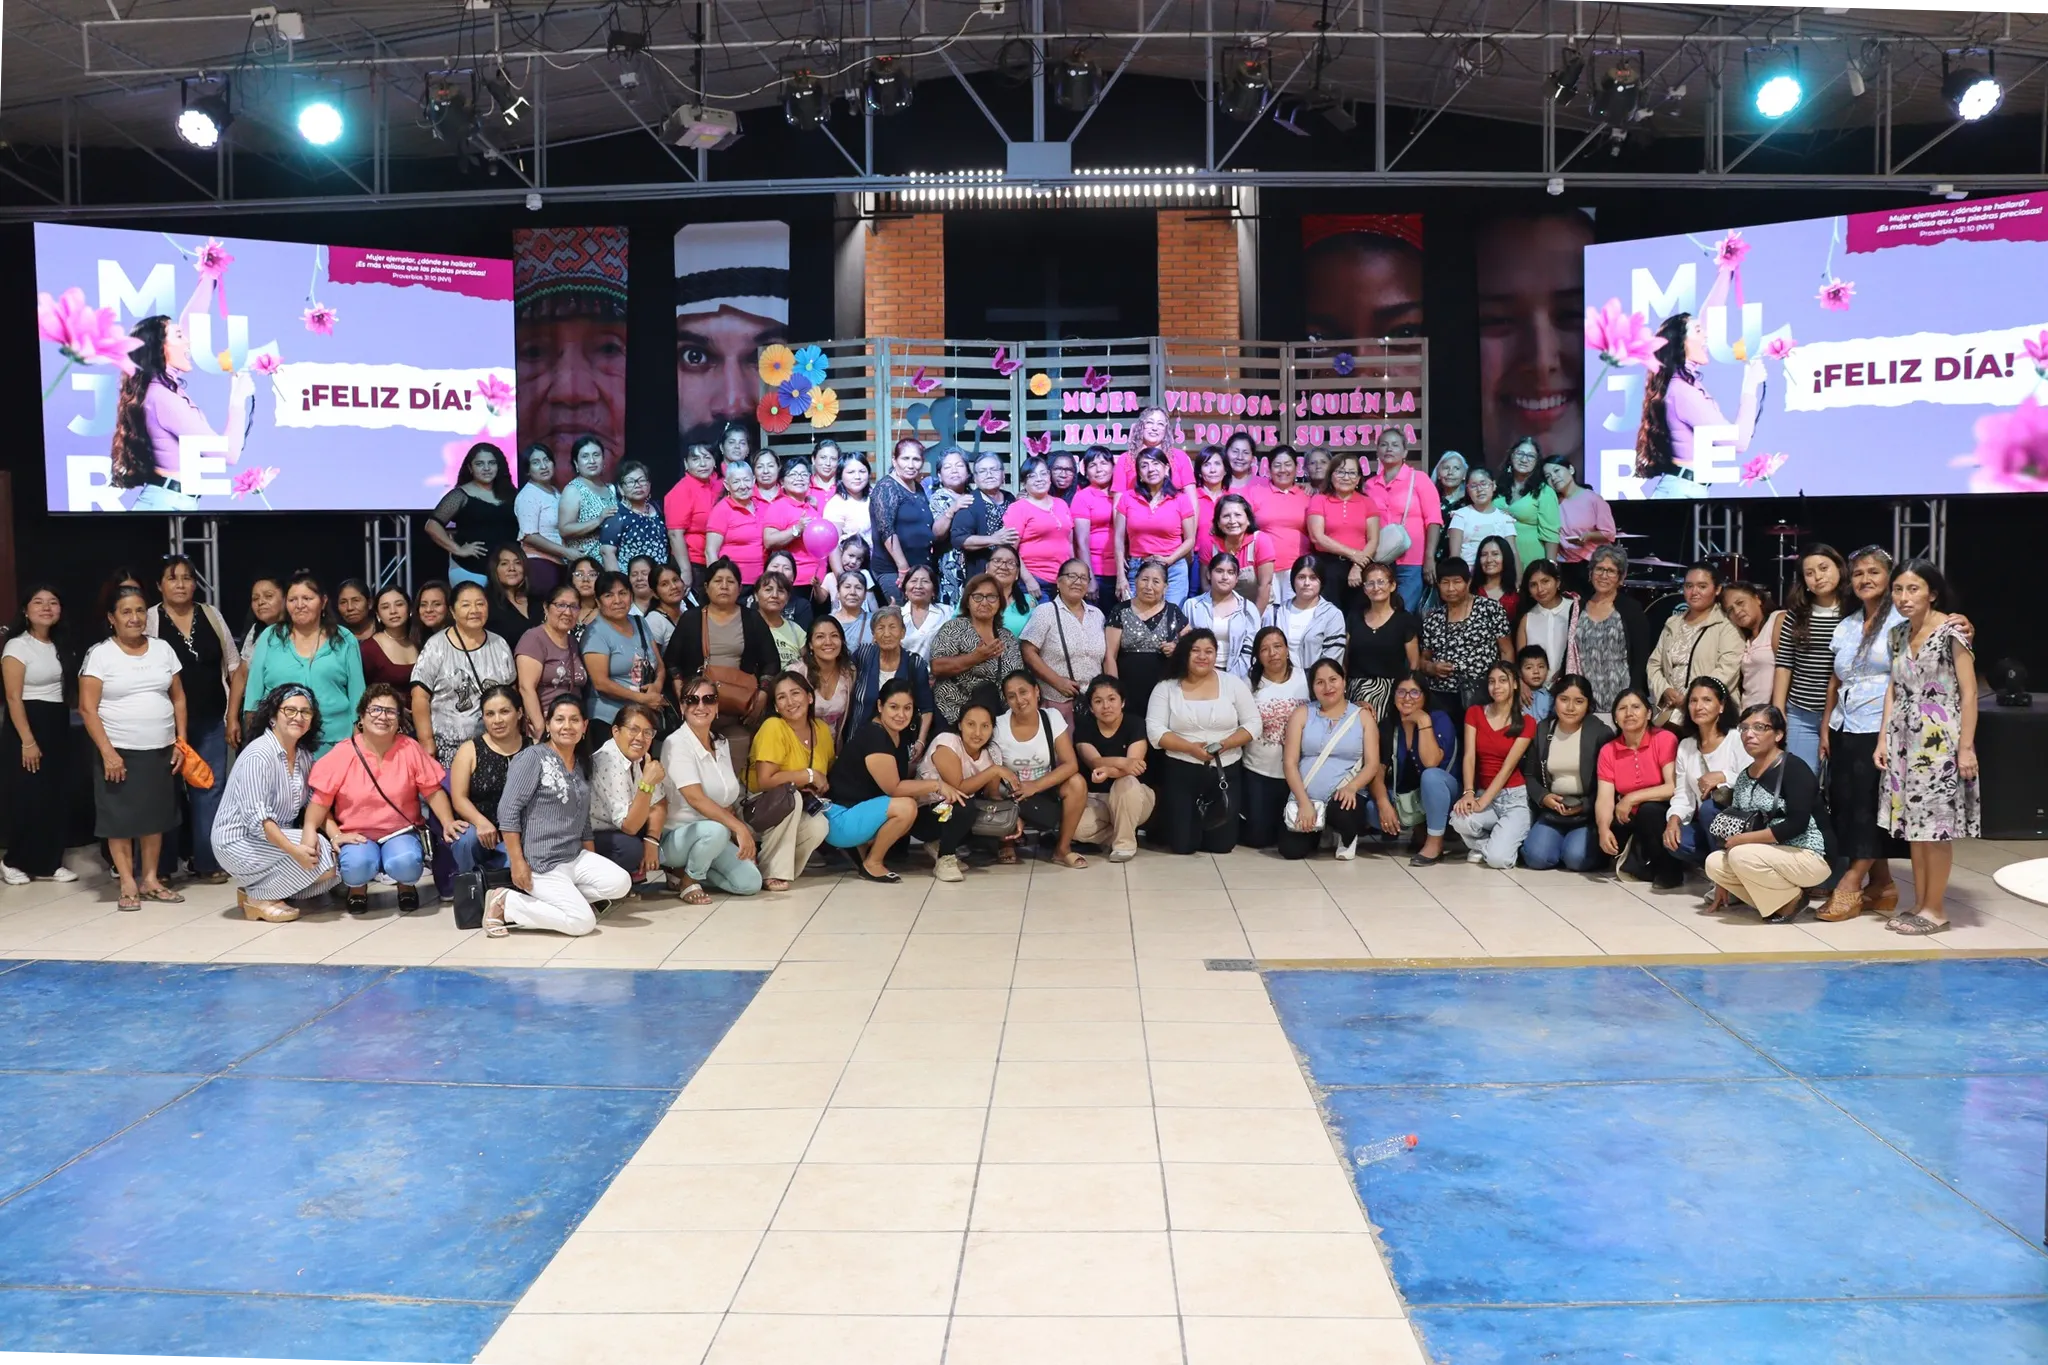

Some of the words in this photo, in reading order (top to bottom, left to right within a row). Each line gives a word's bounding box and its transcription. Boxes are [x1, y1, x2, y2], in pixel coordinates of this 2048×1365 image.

[1889, 213, 1912, 223] Mujer
[1912, 209, 1949, 220] ejemplar,
[1950, 205, 1982, 216] ¿dónde
[1993, 199, 2029, 210] hallará?
[1890, 221, 1907, 231] más
[1908, 219, 1936, 229] valiosa
[1936, 218, 1953, 227] que
[1954, 215, 1966, 224] las
[1967, 212, 1998, 223] piedras
[1999, 207, 2043, 220] preciosas!
[1919, 228, 1958, 237] Proverbios
[366, 254, 385, 262] Mujer
[383, 263, 405, 271] valiosa
[430, 266, 454, 275] piedras
[392, 272, 423, 280] Proverbios
[1813, 359, 1922, 393] ¡FELIZ
[1935, 347, 2015, 382] DÍA!
[302, 384, 400, 411] ¡FELIZ
[409, 382, 472, 411] DÍA!
[1063, 391, 1140, 413] MUJER
[1296, 386, 1381, 417] ¿QUIÉN
[1384, 391, 1416, 413] LA
[1296, 425, 1324, 446] SU
[1328, 423, 1416, 446] ESTIA
